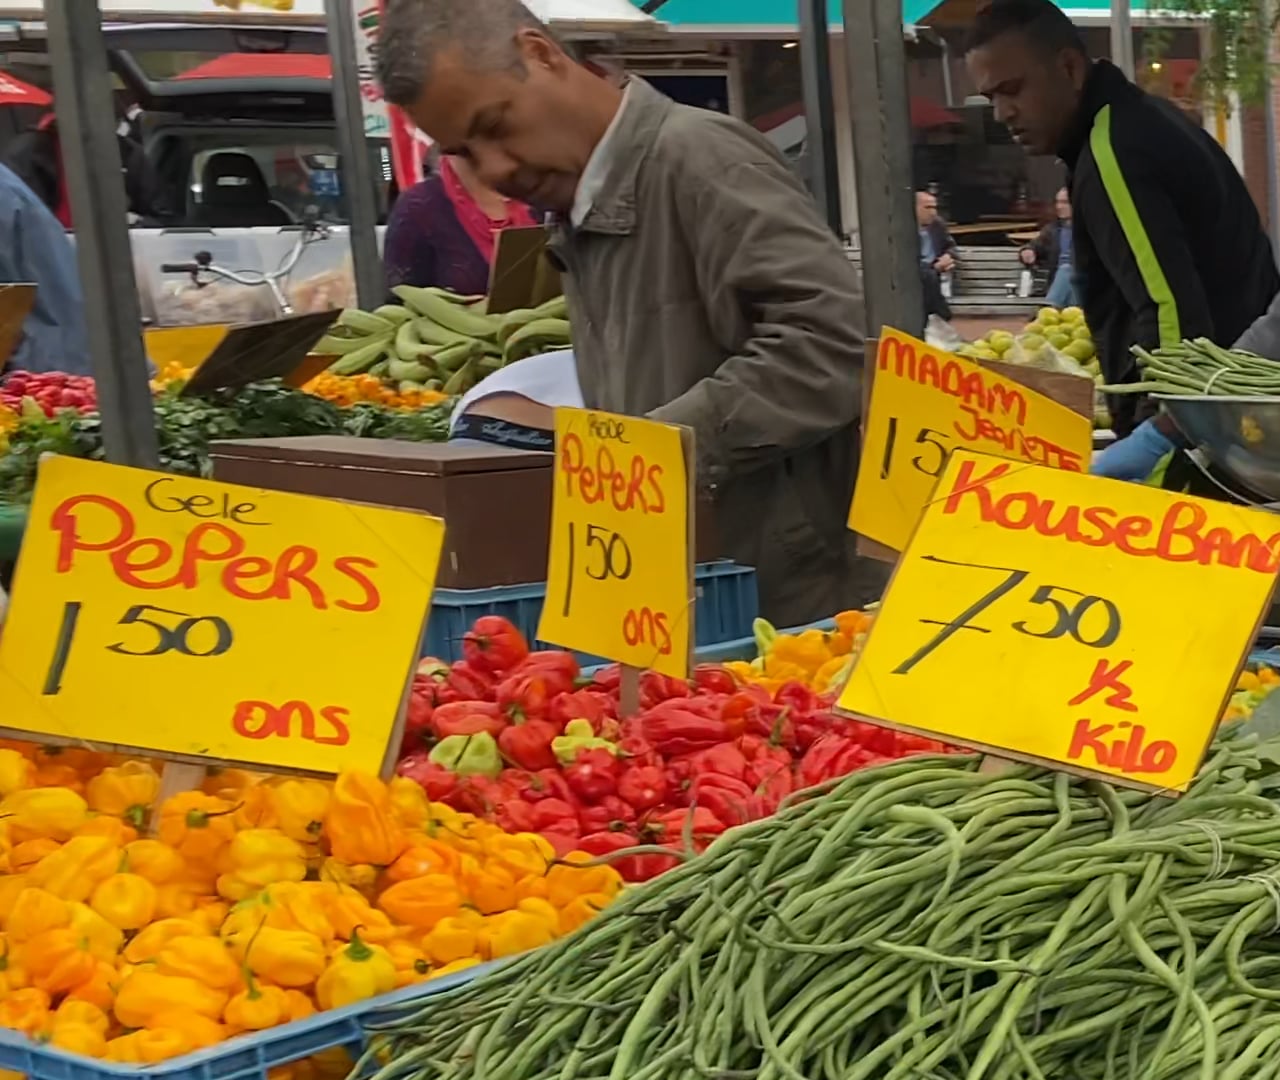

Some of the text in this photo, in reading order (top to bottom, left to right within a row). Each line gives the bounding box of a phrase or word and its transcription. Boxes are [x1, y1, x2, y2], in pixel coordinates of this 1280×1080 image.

[587, 413, 630, 444] Rode
[561, 432, 664, 514] PePeRS
[145, 477, 272, 526] Gele
[50, 494, 382, 613] PePeRS
[623, 607, 672, 655] ons
[233, 700, 351, 745] ons
